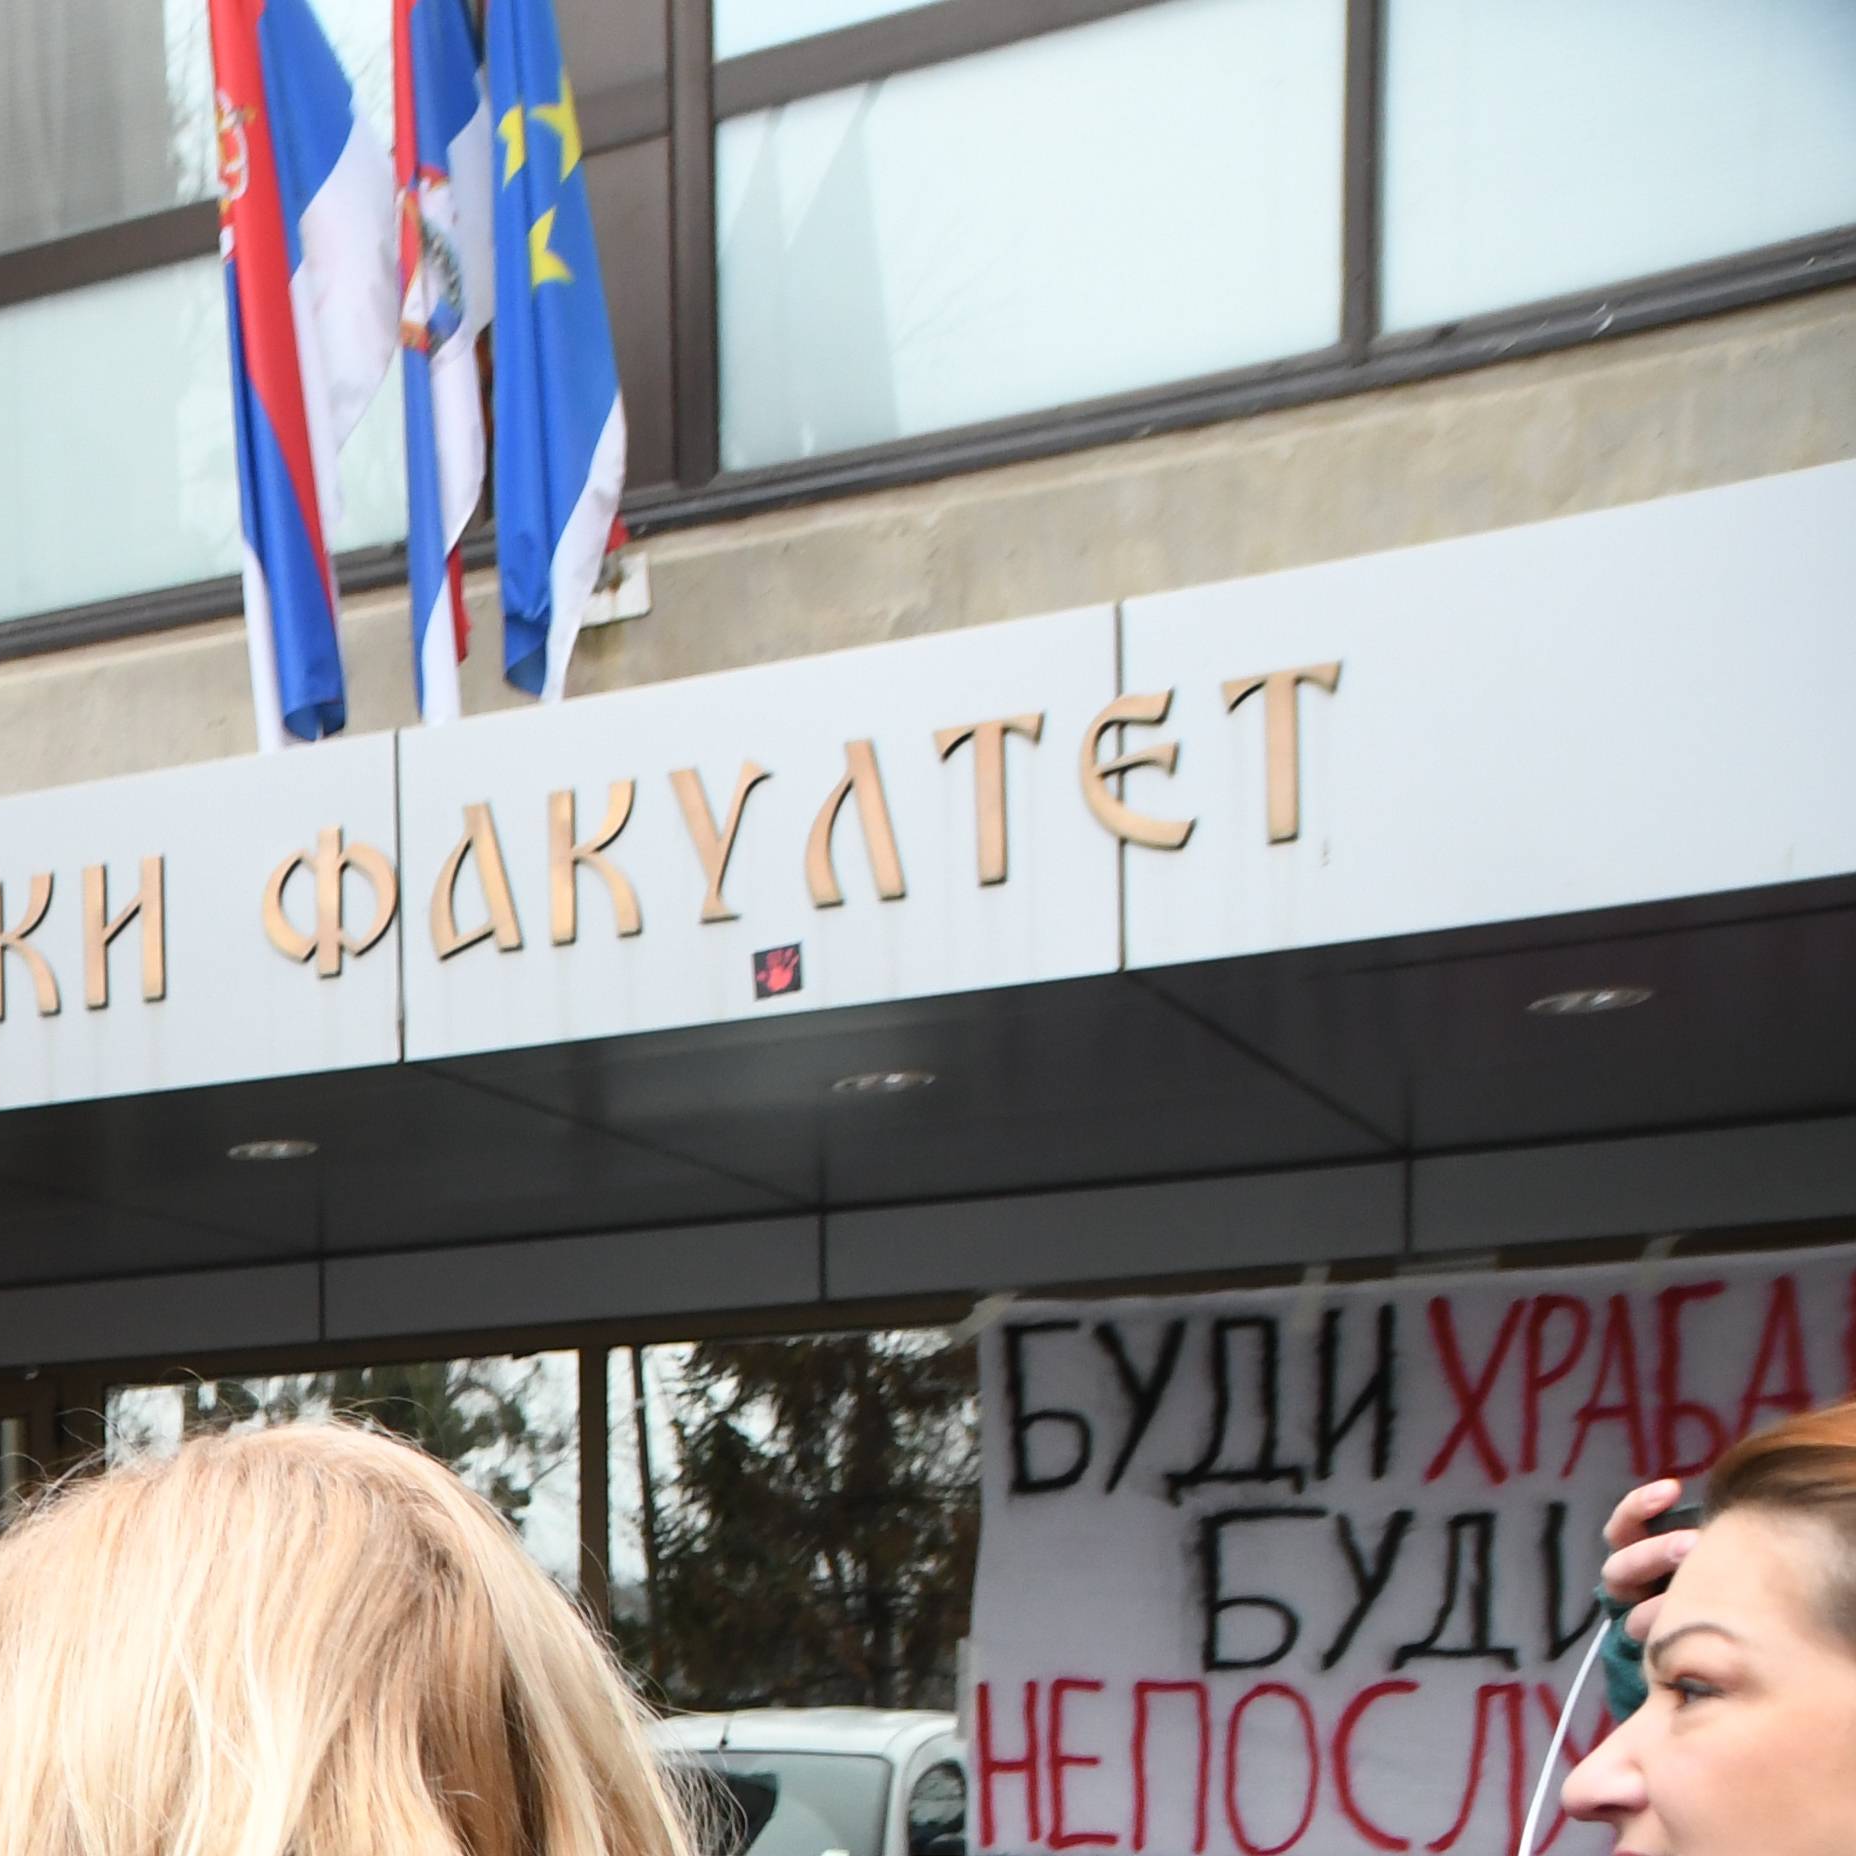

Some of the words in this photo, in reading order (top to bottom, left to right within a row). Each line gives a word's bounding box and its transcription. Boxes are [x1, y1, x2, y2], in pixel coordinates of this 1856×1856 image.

[261, 658, 1343, 979] ФАКУЛТЕТ
[1002, 1303, 1394, 1508] БУДИ
[1424, 1271, 1856, 1486] ХРАБА
